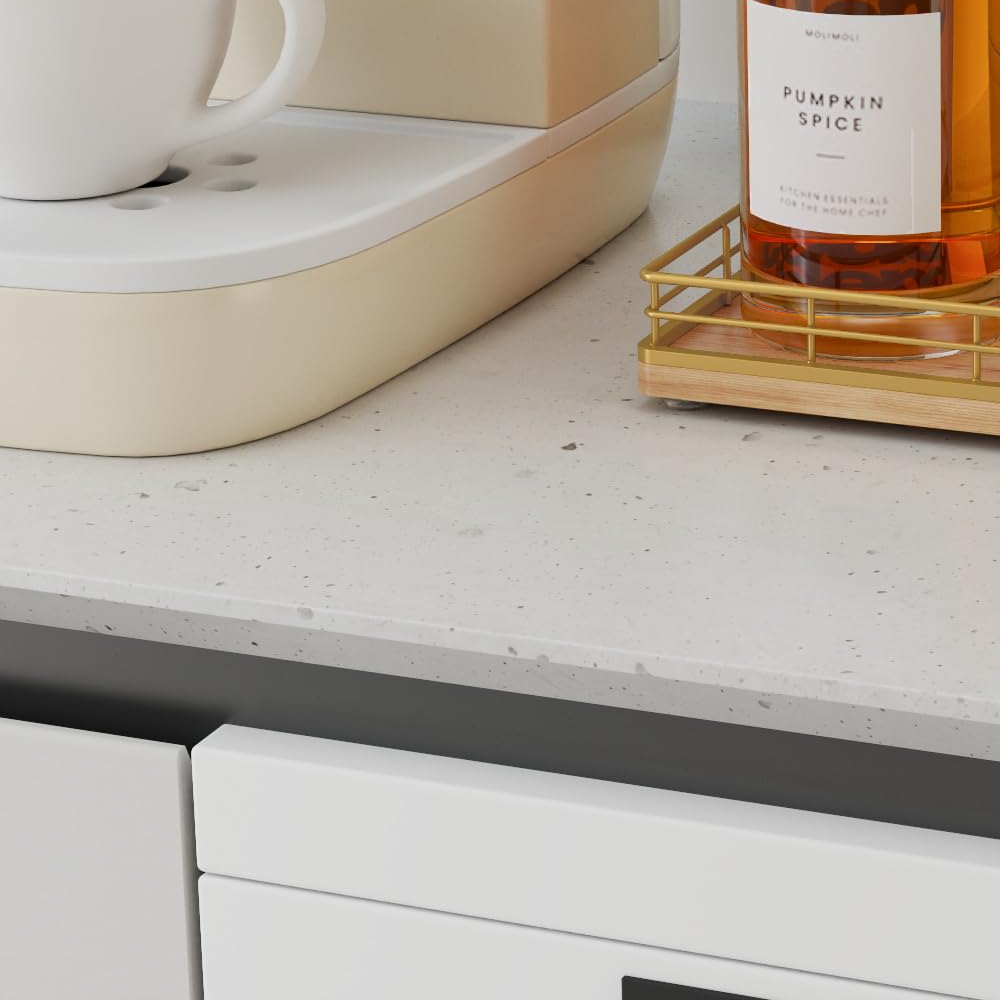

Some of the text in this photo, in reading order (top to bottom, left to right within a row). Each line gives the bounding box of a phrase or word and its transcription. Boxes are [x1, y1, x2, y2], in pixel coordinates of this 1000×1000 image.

[805, 29, 859, 41] MOLIMOLI
[784, 86, 883, 110] PUMPKIN
[799, 112, 862, 132] SPICE
[780, 185, 888, 205] KITCHEN ESSENTIALS
[780, 198, 887, 217] FOR THE HOME CHEF
